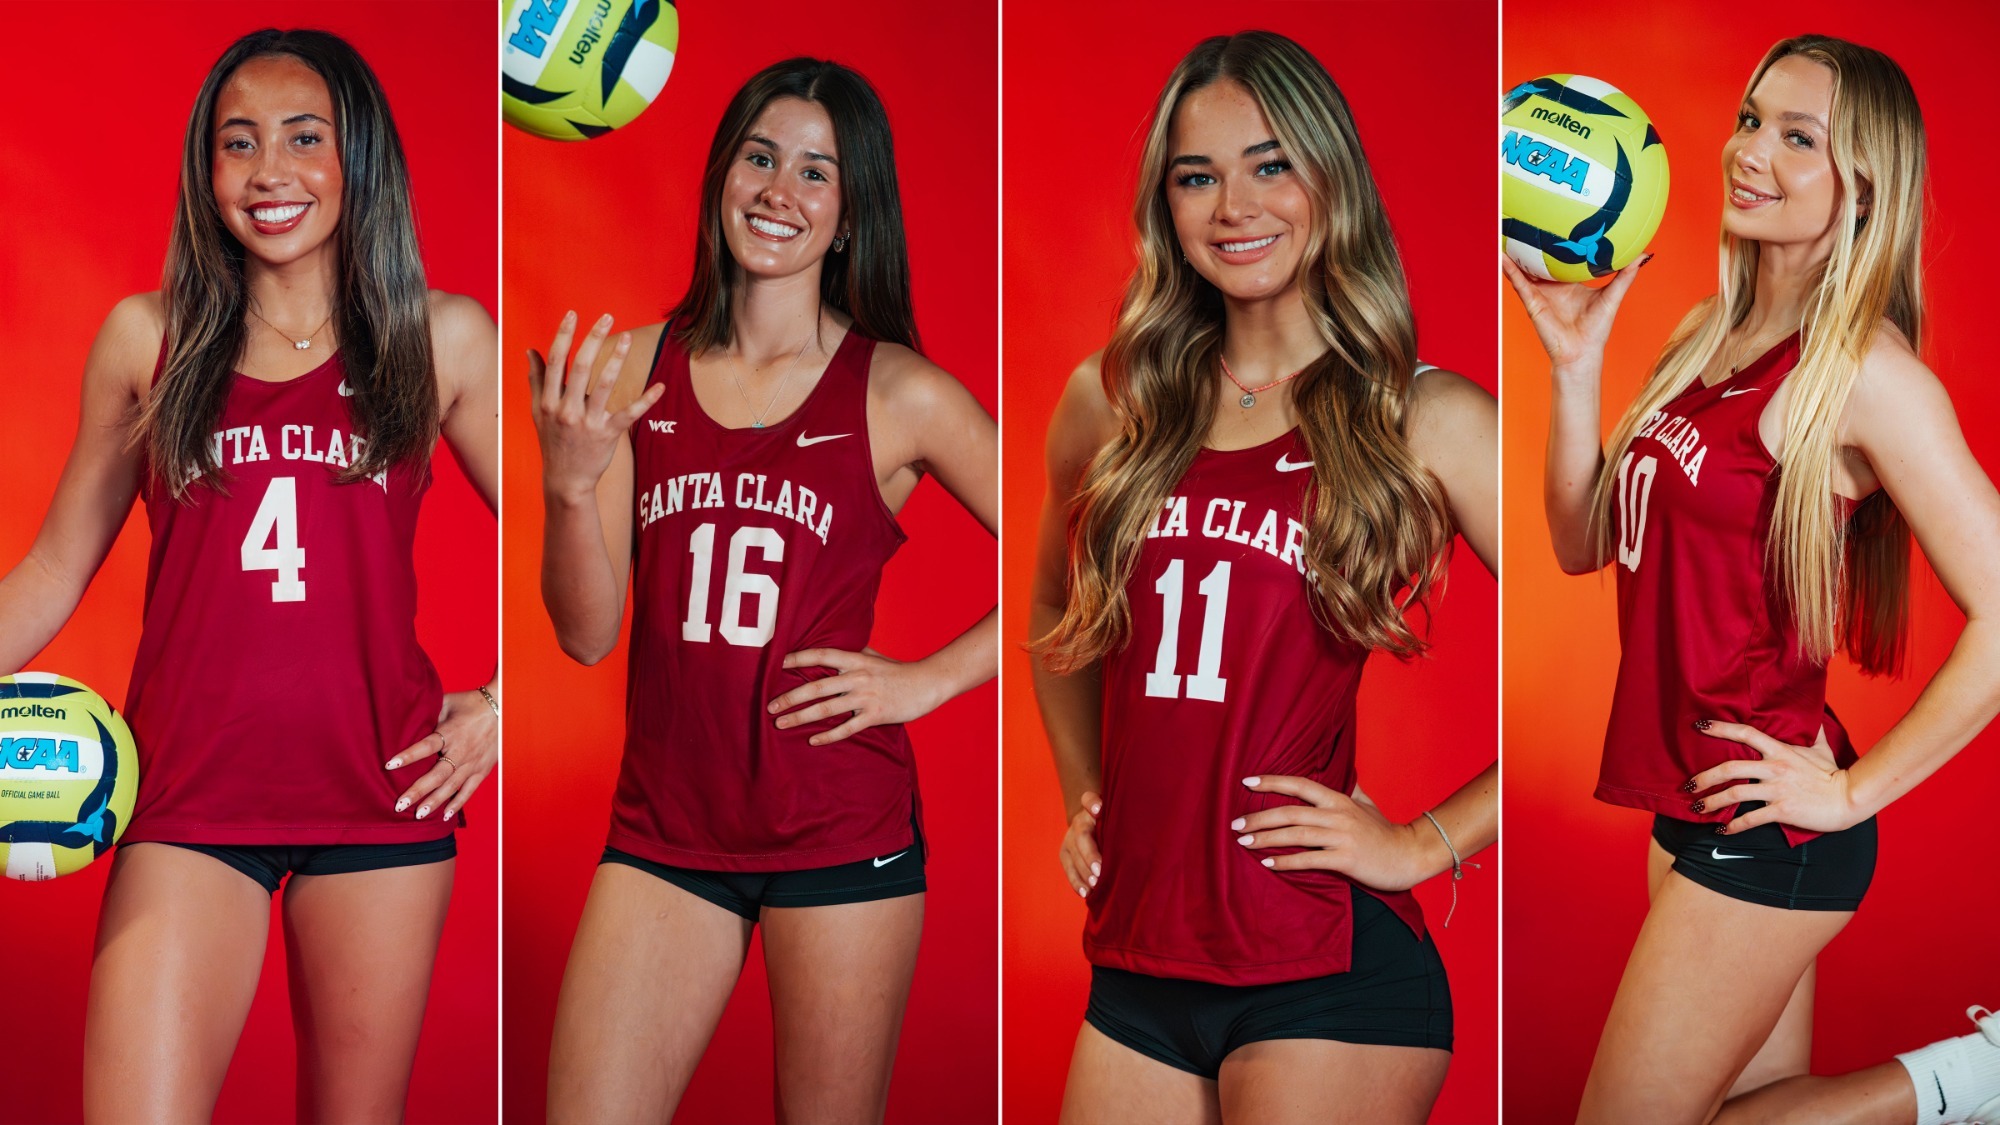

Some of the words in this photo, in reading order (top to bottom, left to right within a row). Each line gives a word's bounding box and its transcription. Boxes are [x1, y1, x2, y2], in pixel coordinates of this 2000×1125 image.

[1530, 106, 1591, 139] molten
[1502, 130, 1590, 194] NCAA
[648, 419, 677, 434] WCC
[1655, 415, 1708, 488] CLARA
[240, 476, 306, 603] 4
[639, 472, 725, 531] SANTA
[735, 472, 833, 546] CLARA
[1618, 451, 1658, 573] 10
[1202, 497, 1324, 597] CLAR
[682, 522, 785, 647] 16
[1145, 558, 1232, 702] 11
[1, 704, 66, 720] molten
[1, 789, 26, 799] OFFICIAL
[28, 791, 45, 799] GAME
[46, 790, 60, 799] BALL
